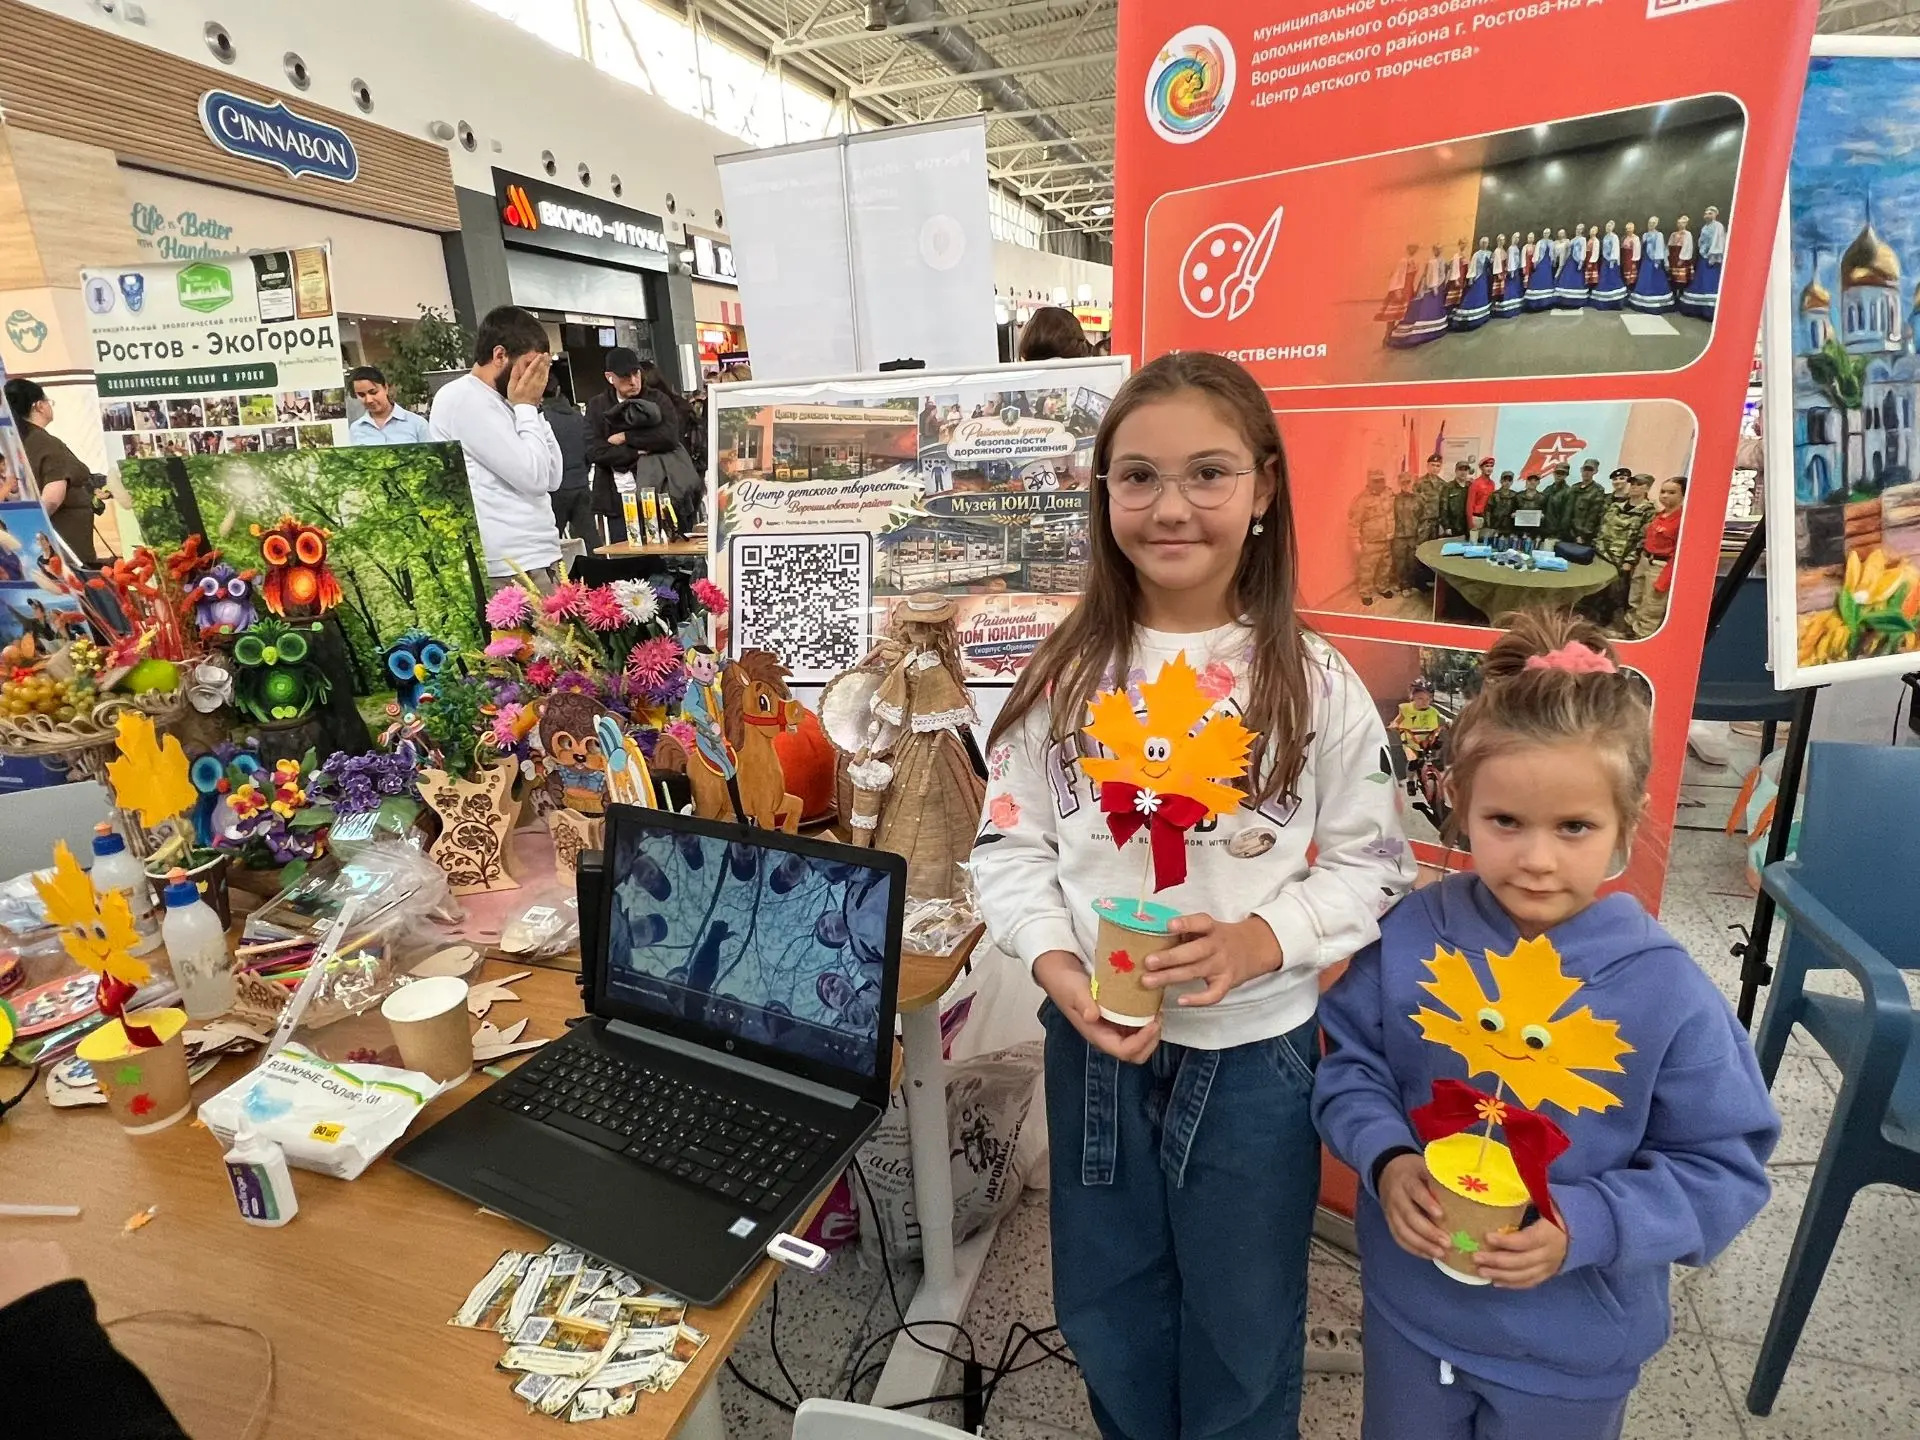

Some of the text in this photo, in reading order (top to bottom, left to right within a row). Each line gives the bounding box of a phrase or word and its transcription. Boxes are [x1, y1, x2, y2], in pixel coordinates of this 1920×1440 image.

[1253, 0, 1375, 42] муниципальное
[1252, 0, 1488, 67] дополнительного образован
[1252, 43, 1381, 86] Ворошиловского
[1385, 23, 1450, 56] района
[1455, 22, 1467, 35] г.
[1250, 44, 1480, 108] «Центр детского творчества»
[218, 105, 348, 168] CINNABON
[131, 202, 164, 236] Life
[177, 212, 233, 240] Better
[538, 200, 603, 238] ВКУСНО
[626, 224, 669, 253] ТОЧКА
[162, 319, 224, 330] ЭКОЛОГИЧЕСКИЙ
[229, 316, 257, 324] ПРОЕКТ
[96, 340, 184, 362] Ростов
[207, 326, 334, 355] ЭкоГород
[1169, 343, 1327, 362] ественная
[108, 370, 264, 389] ЭКОЛОГИЧЕСКИЕ АКЦИИ И УРОКИ
[962, 422, 1054, 441] Районный центр
[974, 438, 1046, 447] безопасности
[954, 444, 1068, 457] дорожного движения
[737, 481, 784, 512] Центр
[785, 485, 837, 505] детского
[787, 499, 892, 516] Ворошиловского района
[951, 494, 1082, 515] Музей ЮИД Дона
[972, 612, 1037, 629] Районный
[957, 623, 1055, 646] ДОМ ЮНАРМИИ
[974, 645, 1001, 655] (корпус
[268, 1060, 324, 1084] ВЛАЖНЫЕ
[321, 1080, 381, 1104] САЛФЕКИ
[313, 1125, 326, 1136] 80
